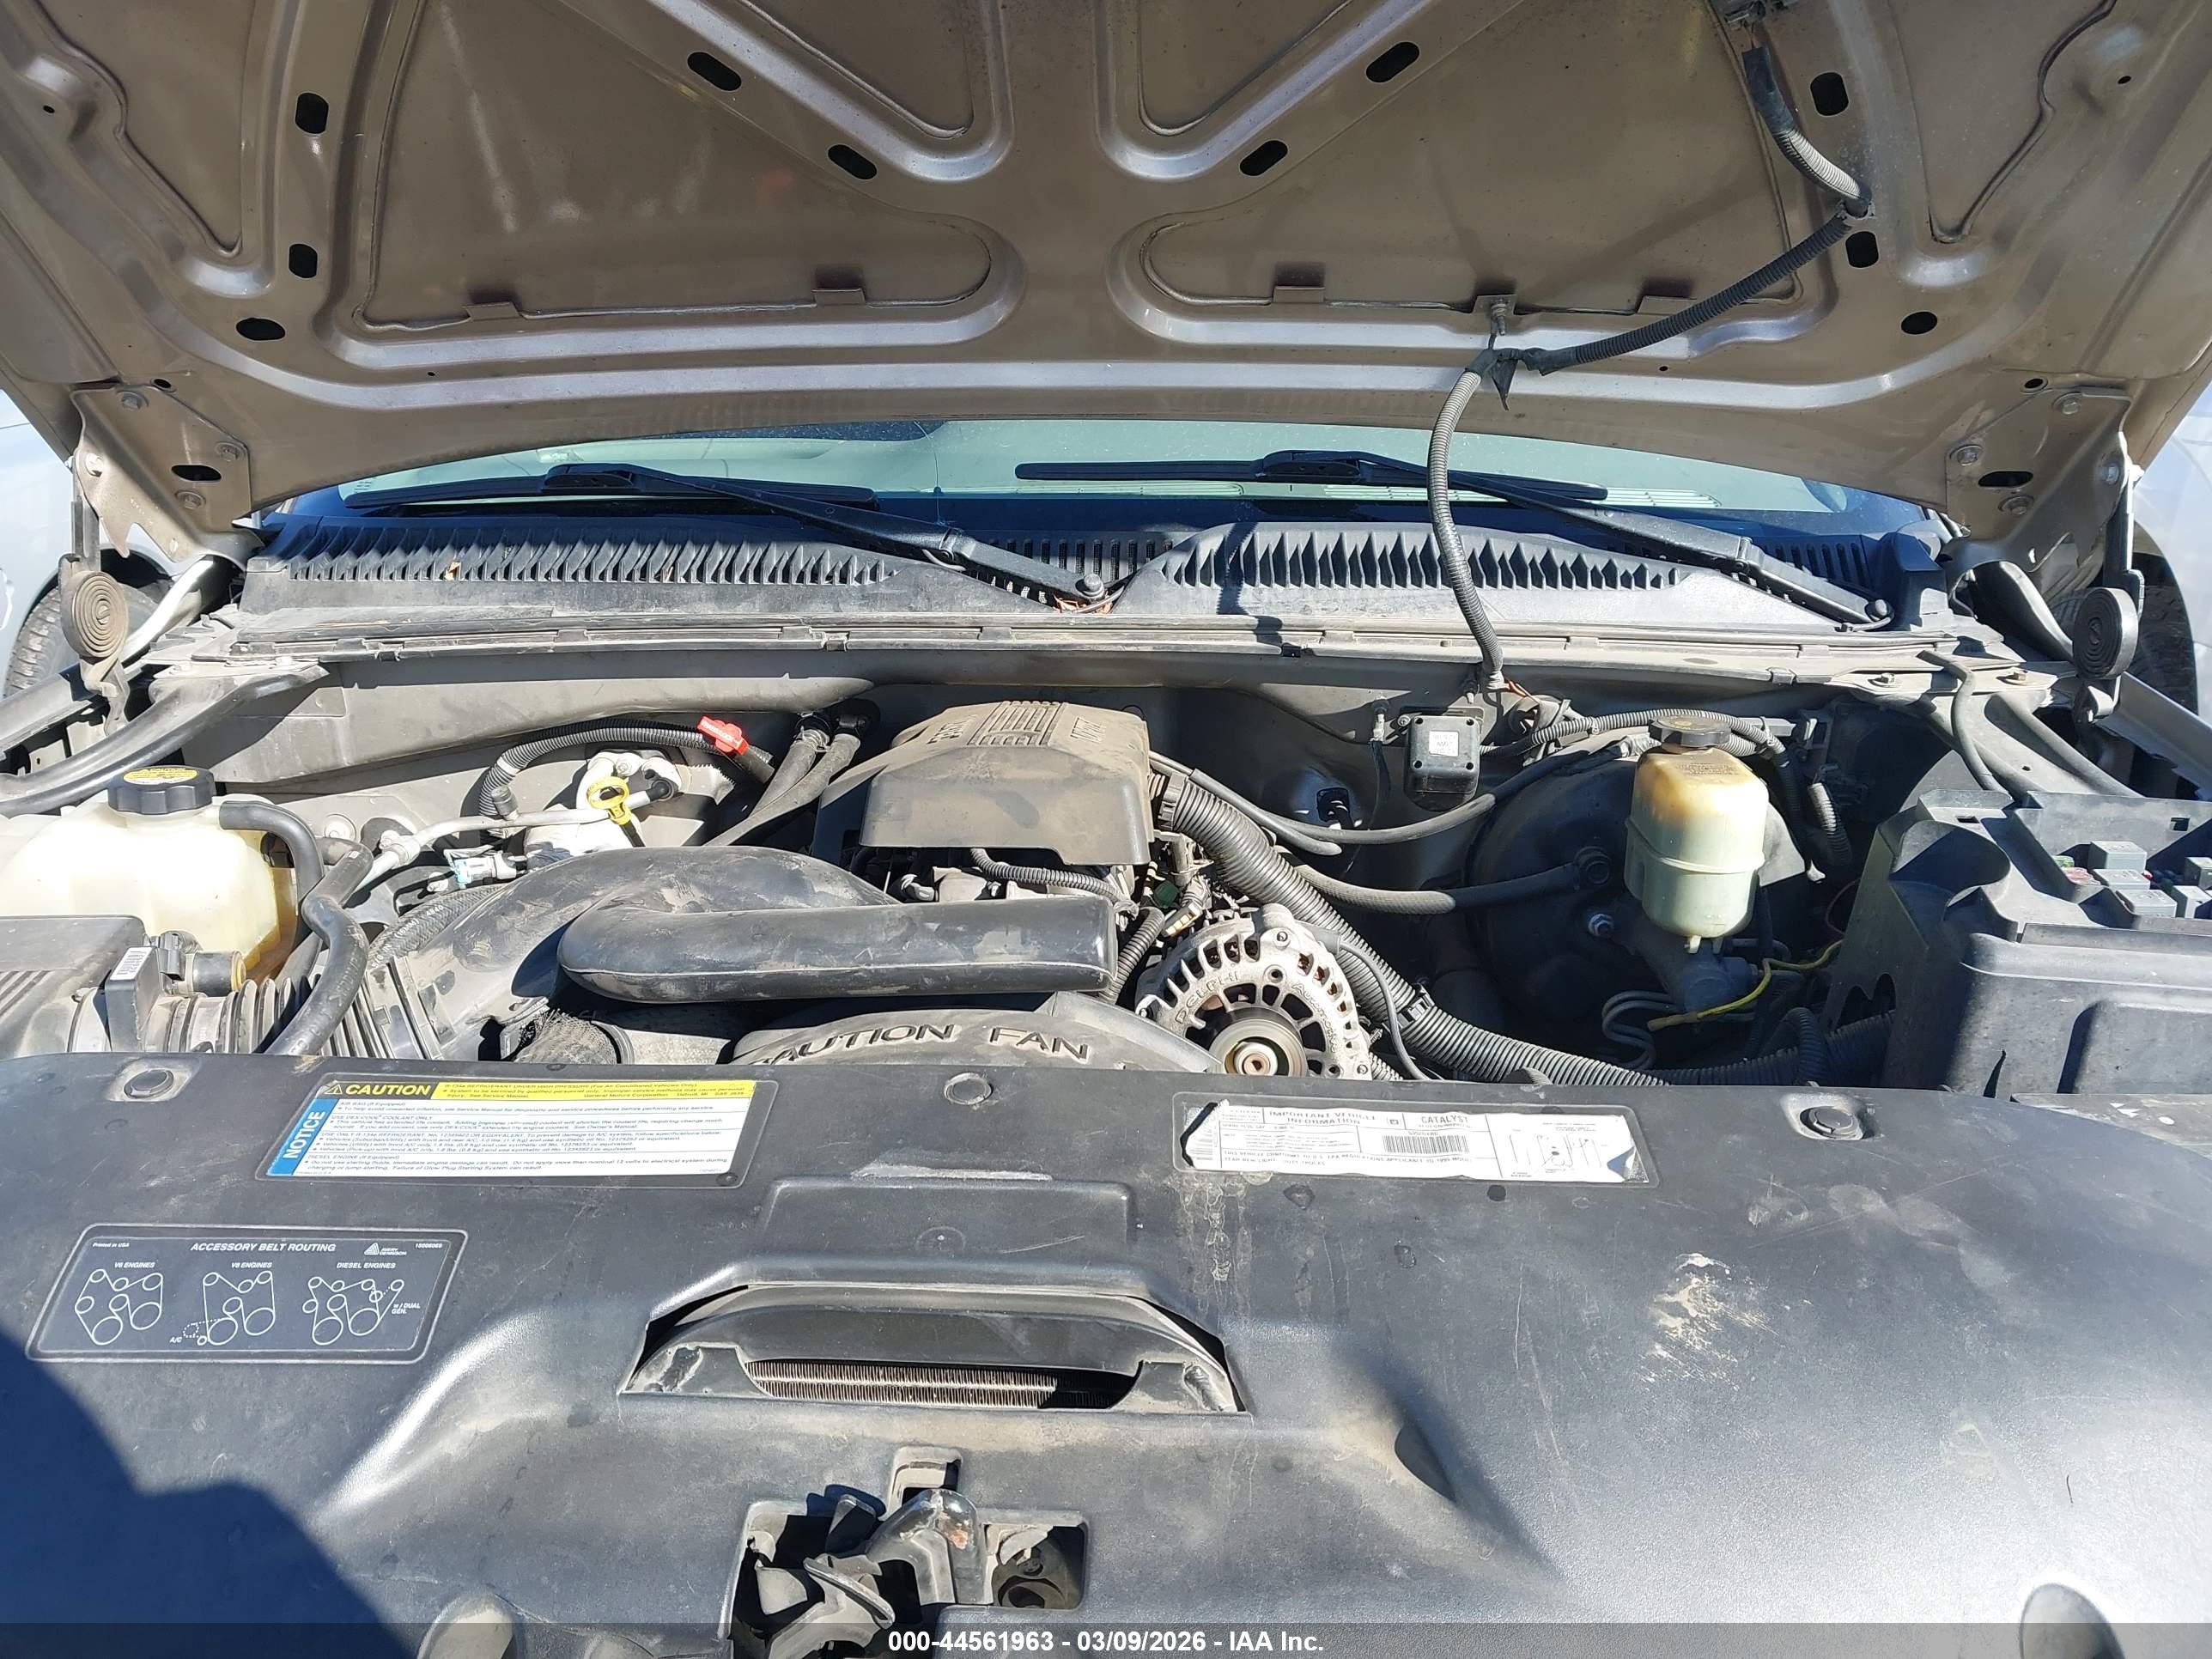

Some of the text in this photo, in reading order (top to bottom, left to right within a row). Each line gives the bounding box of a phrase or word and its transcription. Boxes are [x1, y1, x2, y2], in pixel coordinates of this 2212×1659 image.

[989, 1026, 1091, 1063] FAN
[346, 1085, 431, 1096] CAUTION
[1421, 1115, 1468, 1124] CATALYST
[283, 1111, 325, 1160] NOTICE
[190, 1243, 258, 1251] ACCESSORY
[287, 1243, 336, 1252] ROUTING
